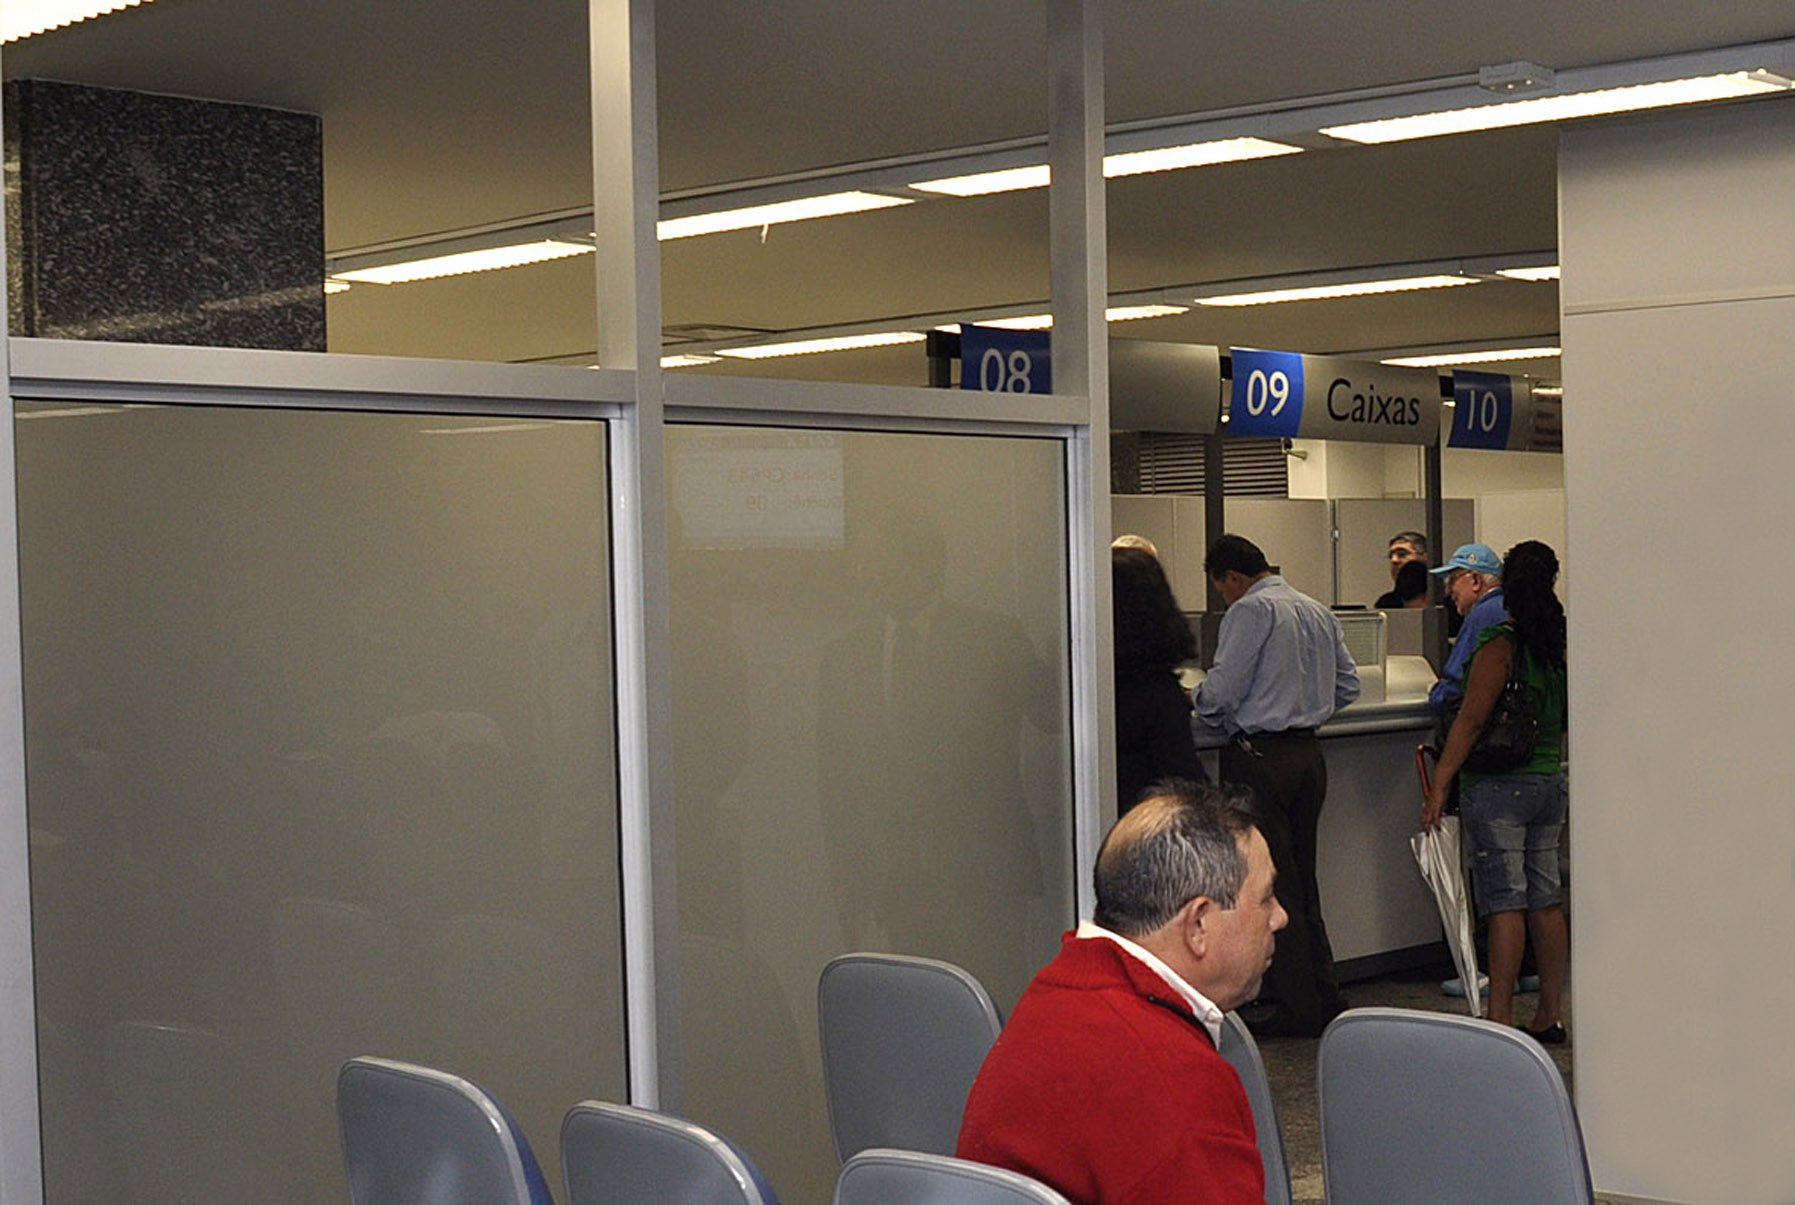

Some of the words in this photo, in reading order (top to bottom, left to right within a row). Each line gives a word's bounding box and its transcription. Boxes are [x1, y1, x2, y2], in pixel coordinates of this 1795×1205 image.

[980, 347, 1032, 393] 08
[1246, 369, 1290, 417] 09
[1327, 378, 1421, 426] Caixas
[1467, 389, 1498, 432] 10
